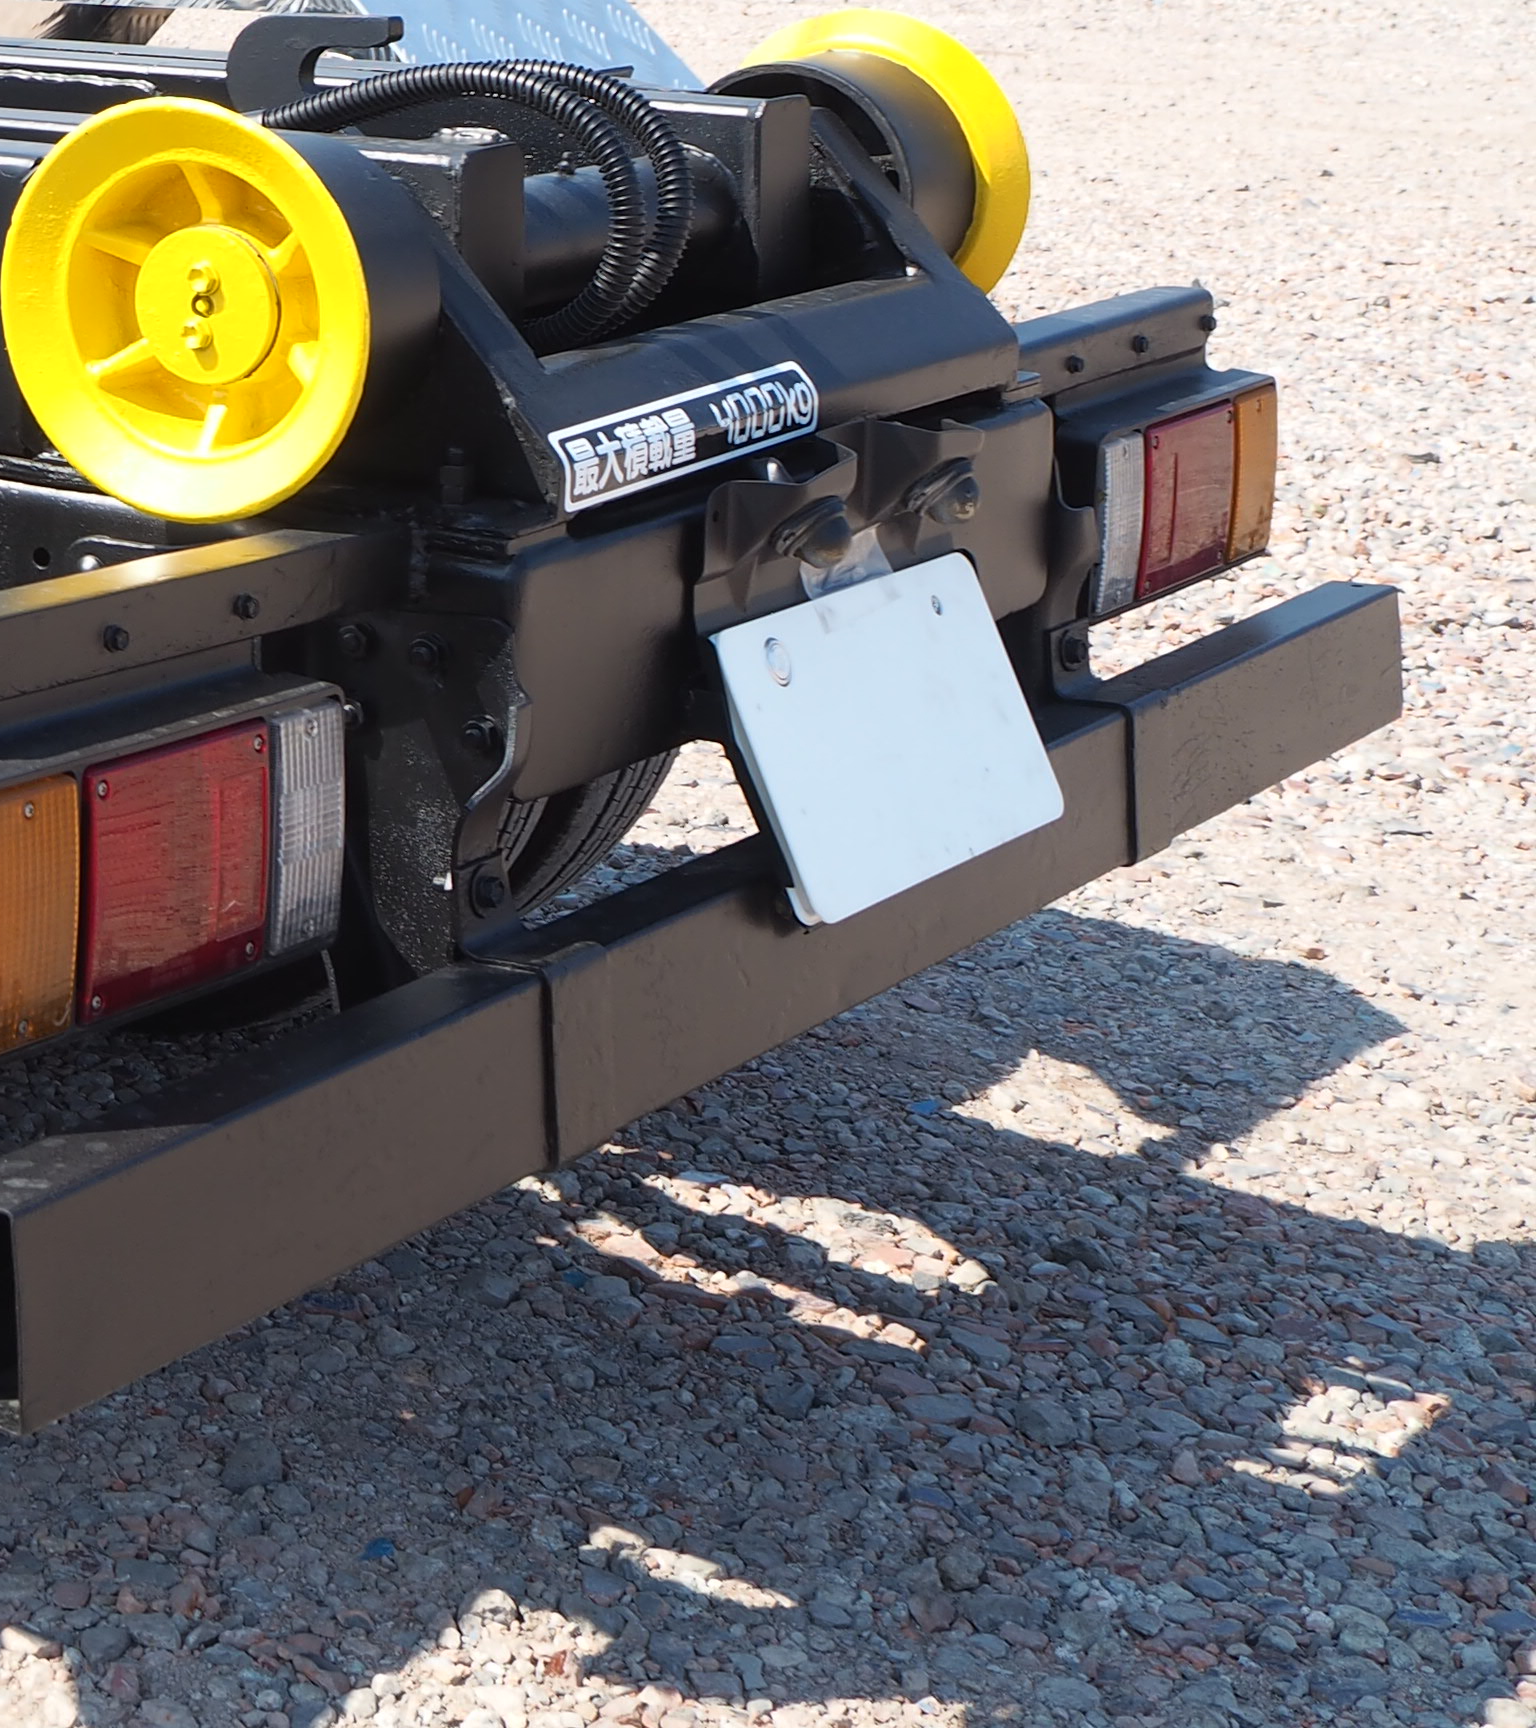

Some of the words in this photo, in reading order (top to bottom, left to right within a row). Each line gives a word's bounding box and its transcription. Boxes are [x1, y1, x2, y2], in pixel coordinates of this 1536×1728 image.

[564, 407, 697, 496] 最大積載量
[709, 380, 814, 446] 4000kg
